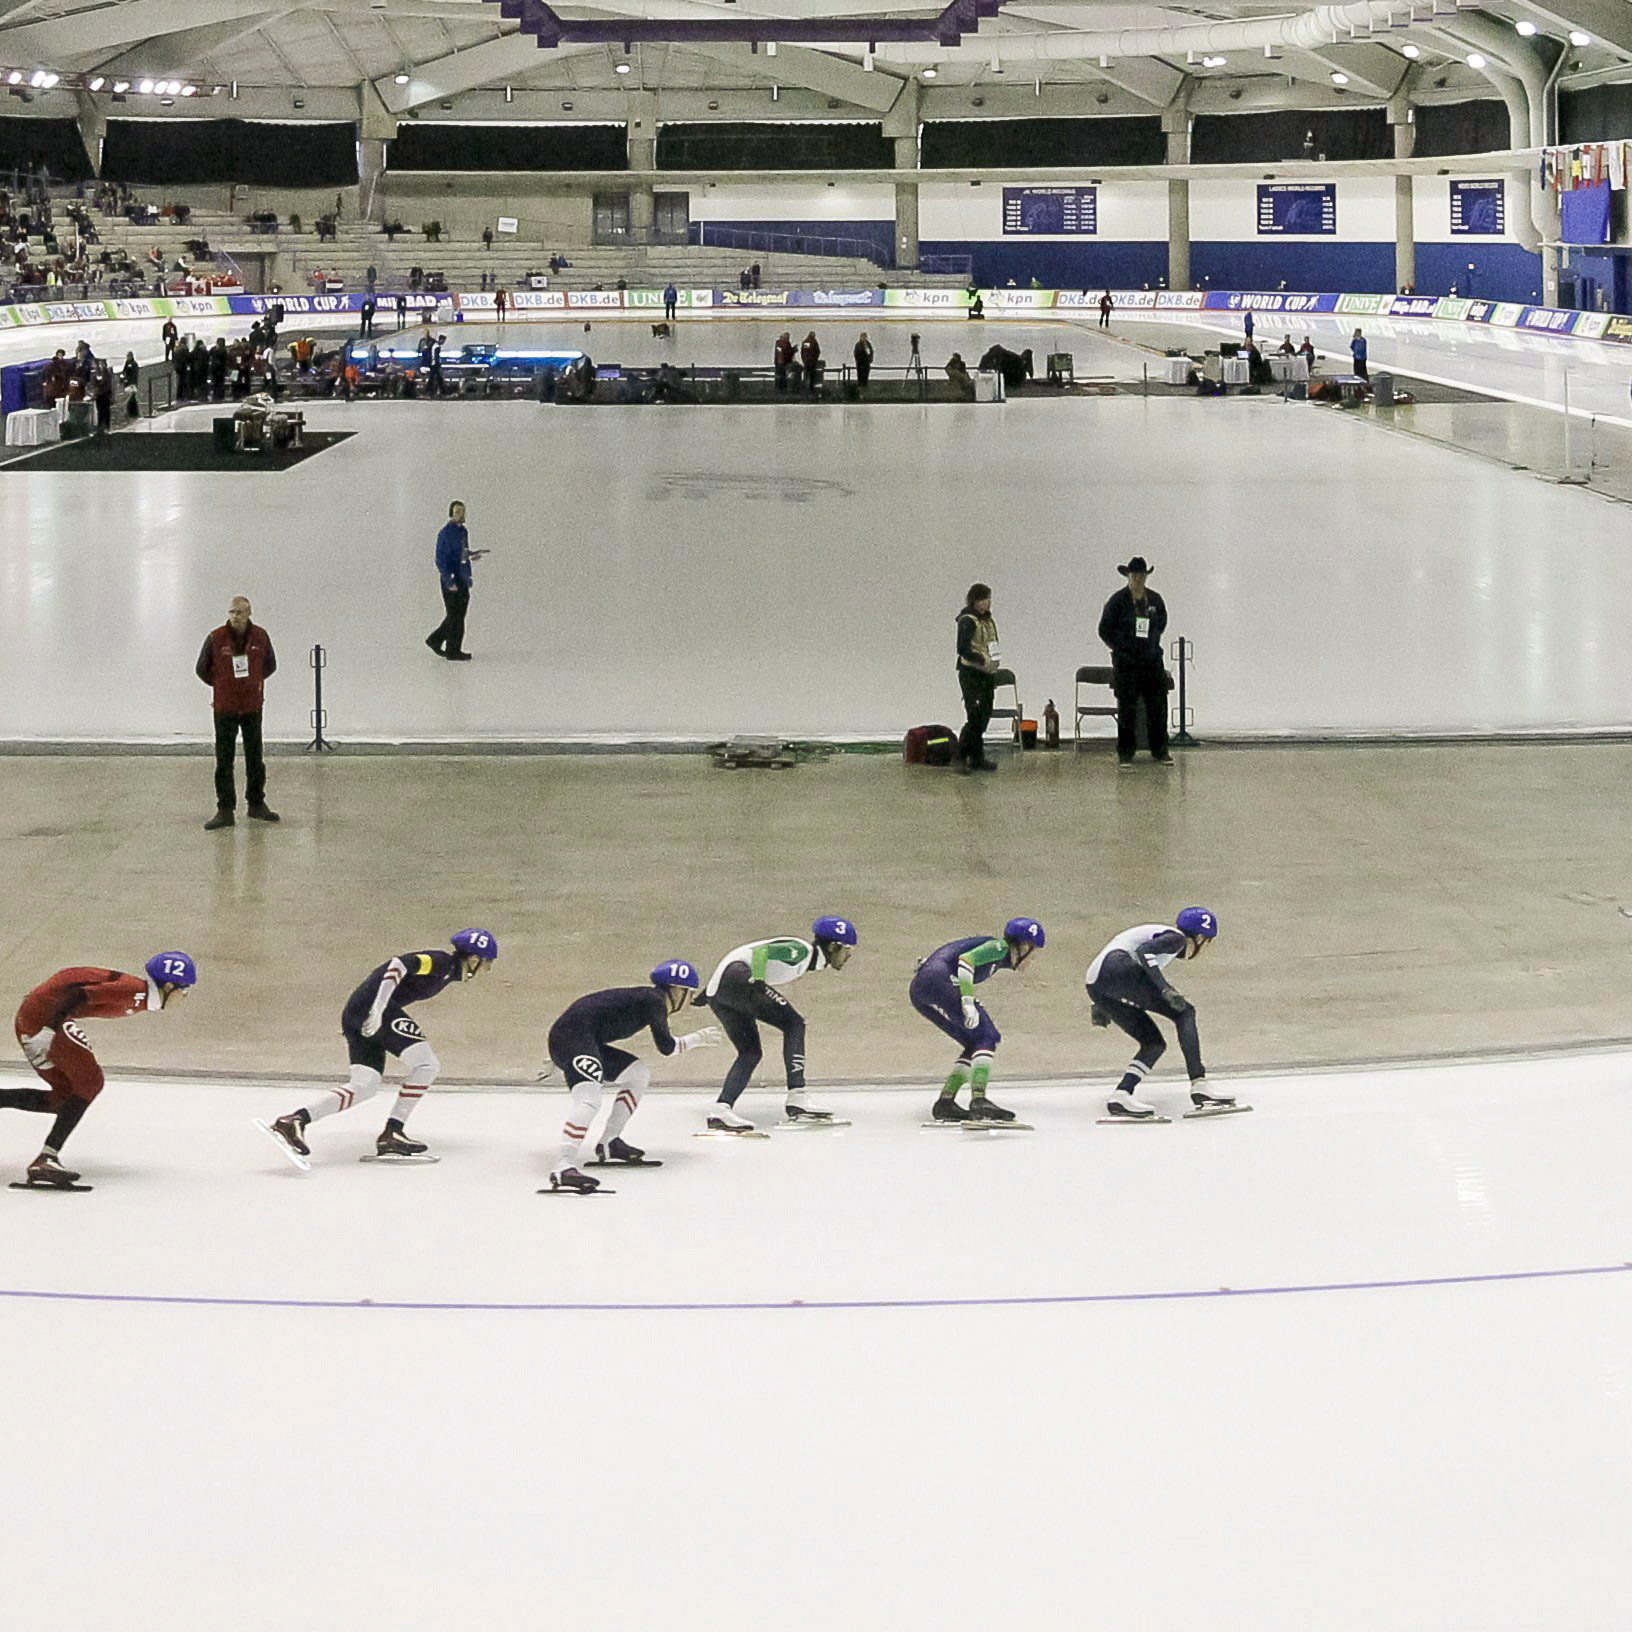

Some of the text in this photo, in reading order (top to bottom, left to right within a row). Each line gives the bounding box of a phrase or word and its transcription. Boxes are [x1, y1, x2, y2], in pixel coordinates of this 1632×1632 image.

[314, 296, 337, 310] CUP
[515, 294, 564, 306] DKB.de
[569, 294, 618, 306] DKB.de
[923, 292, 949, 304] kpn
[1007, 292, 1033, 304] kpn
[1158, 294, 1201, 306] DKB.de
[1240, 294, 1283, 310] WORLD
[192, 300, 213, 315] kpn
[835, 921, 847, 935] 3
[1200, 913, 1212, 929] 2
[469, 932, 489, 949] 15
[163, 959, 186, 977] 12
[669, 963, 689, 979] 10
